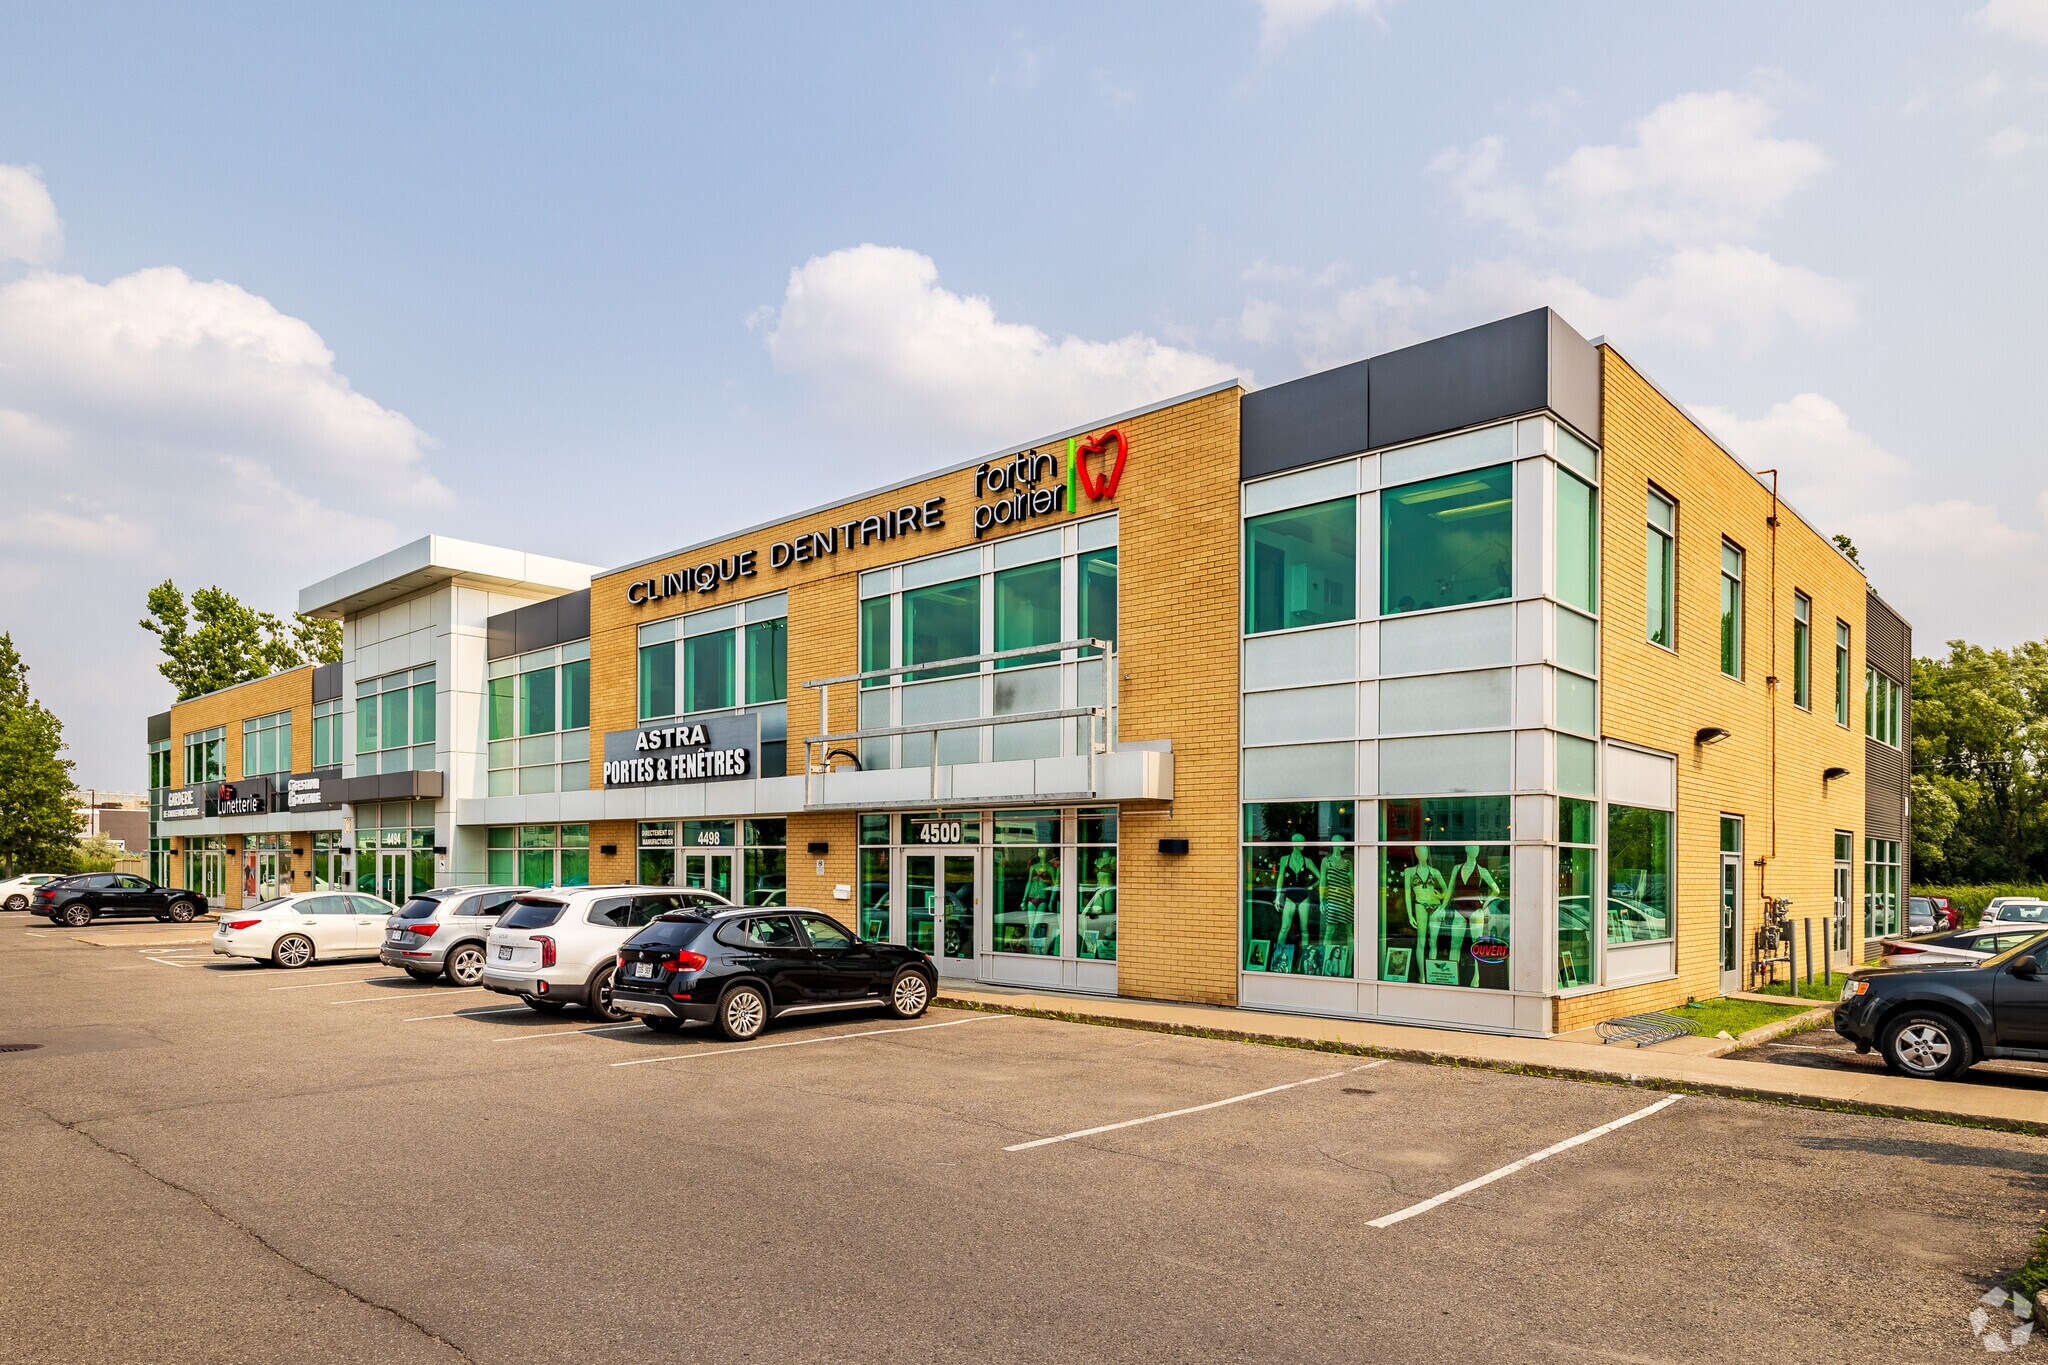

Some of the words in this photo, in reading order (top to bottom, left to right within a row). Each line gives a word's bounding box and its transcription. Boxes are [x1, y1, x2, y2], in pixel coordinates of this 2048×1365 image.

[975, 448, 1057, 498] fortin
[974, 483, 1066, 538] poirier
[627, 549, 757, 605] CLINIQUE
[770, 496, 944, 569] DENTAIRE
[636, 724, 707, 752] ASTRA
[603, 757, 654, 784] PORTES
[656, 759, 669, 781] &
[671, 748, 746, 780] FENÊTRES
[168, 790, 194, 807] GARDERIE
[218, 794, 258, 815] Lunetterie
[387, 832, 401, 846] 4494
[641, 829, 668, 837] DIRECTEMENT
[642, 838, 674, 846] MANUFACTURIER
[698, 831, 720, 845] 4498
[920, 822, 961, 843] 4500
[1473, 944, 1508, 957] OUVERT
